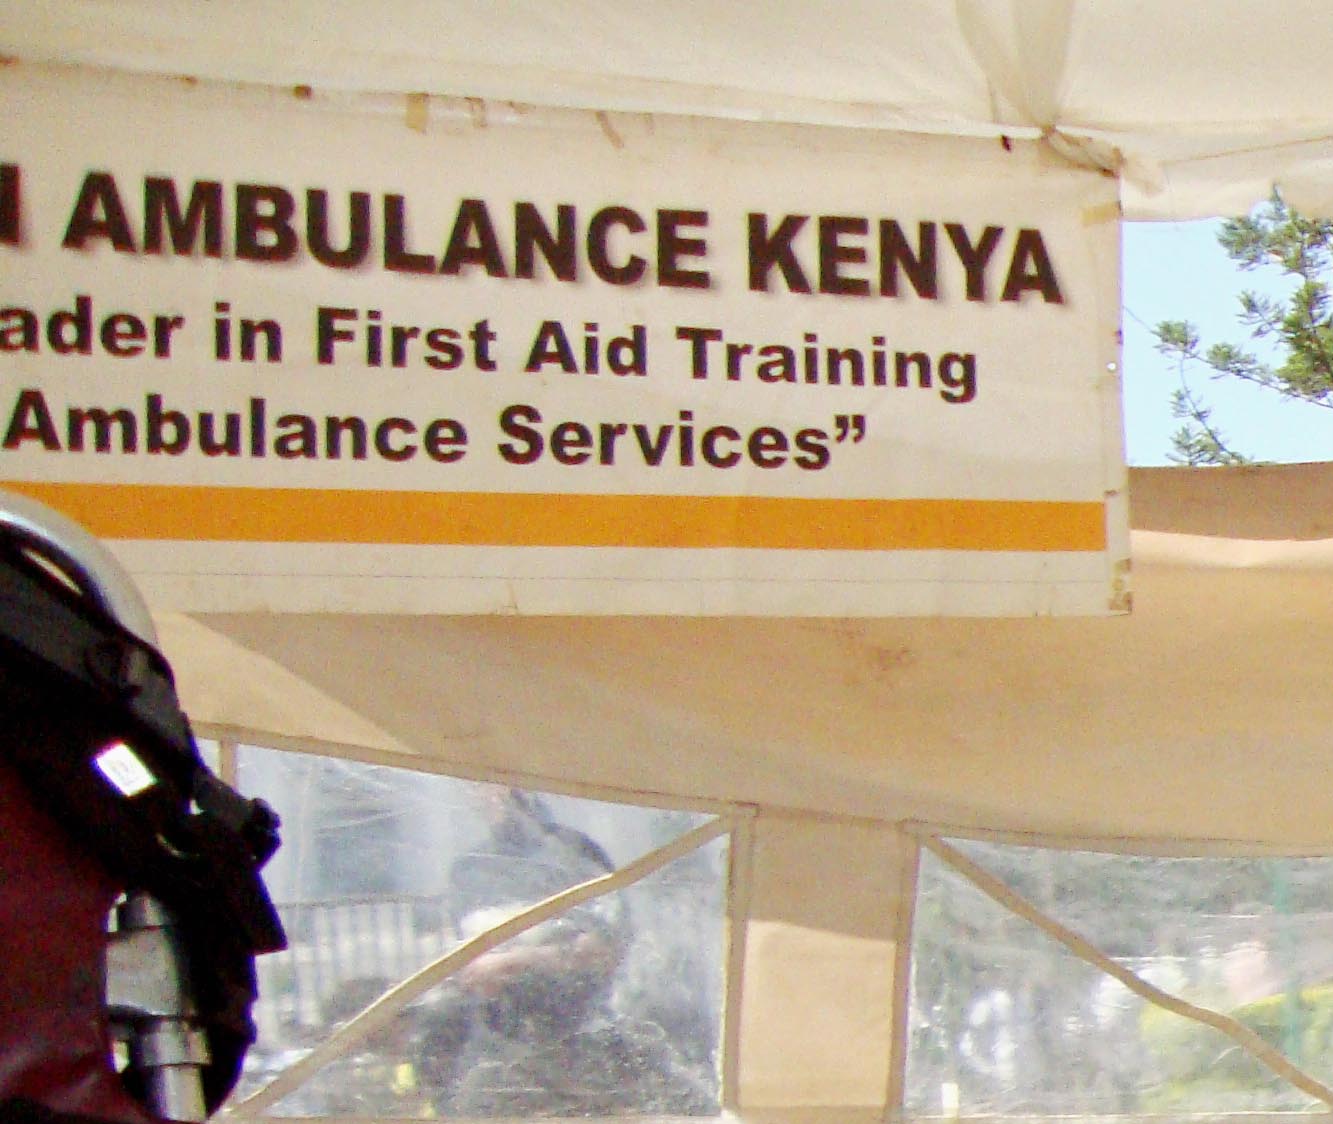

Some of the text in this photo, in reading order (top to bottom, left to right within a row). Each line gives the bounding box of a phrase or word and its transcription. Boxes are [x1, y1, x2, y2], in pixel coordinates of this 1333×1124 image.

[62, 170, 711, 289] AMBULANCE
[748, 212, 1065, 305] KENYA
[214, 301, 283, 363] in
[316, 306, 498, 373] First
[523, 320, 648, 377] Aid
[675, 326, 978, 403] Training
[2, 389, 468, 464] Ambulance
